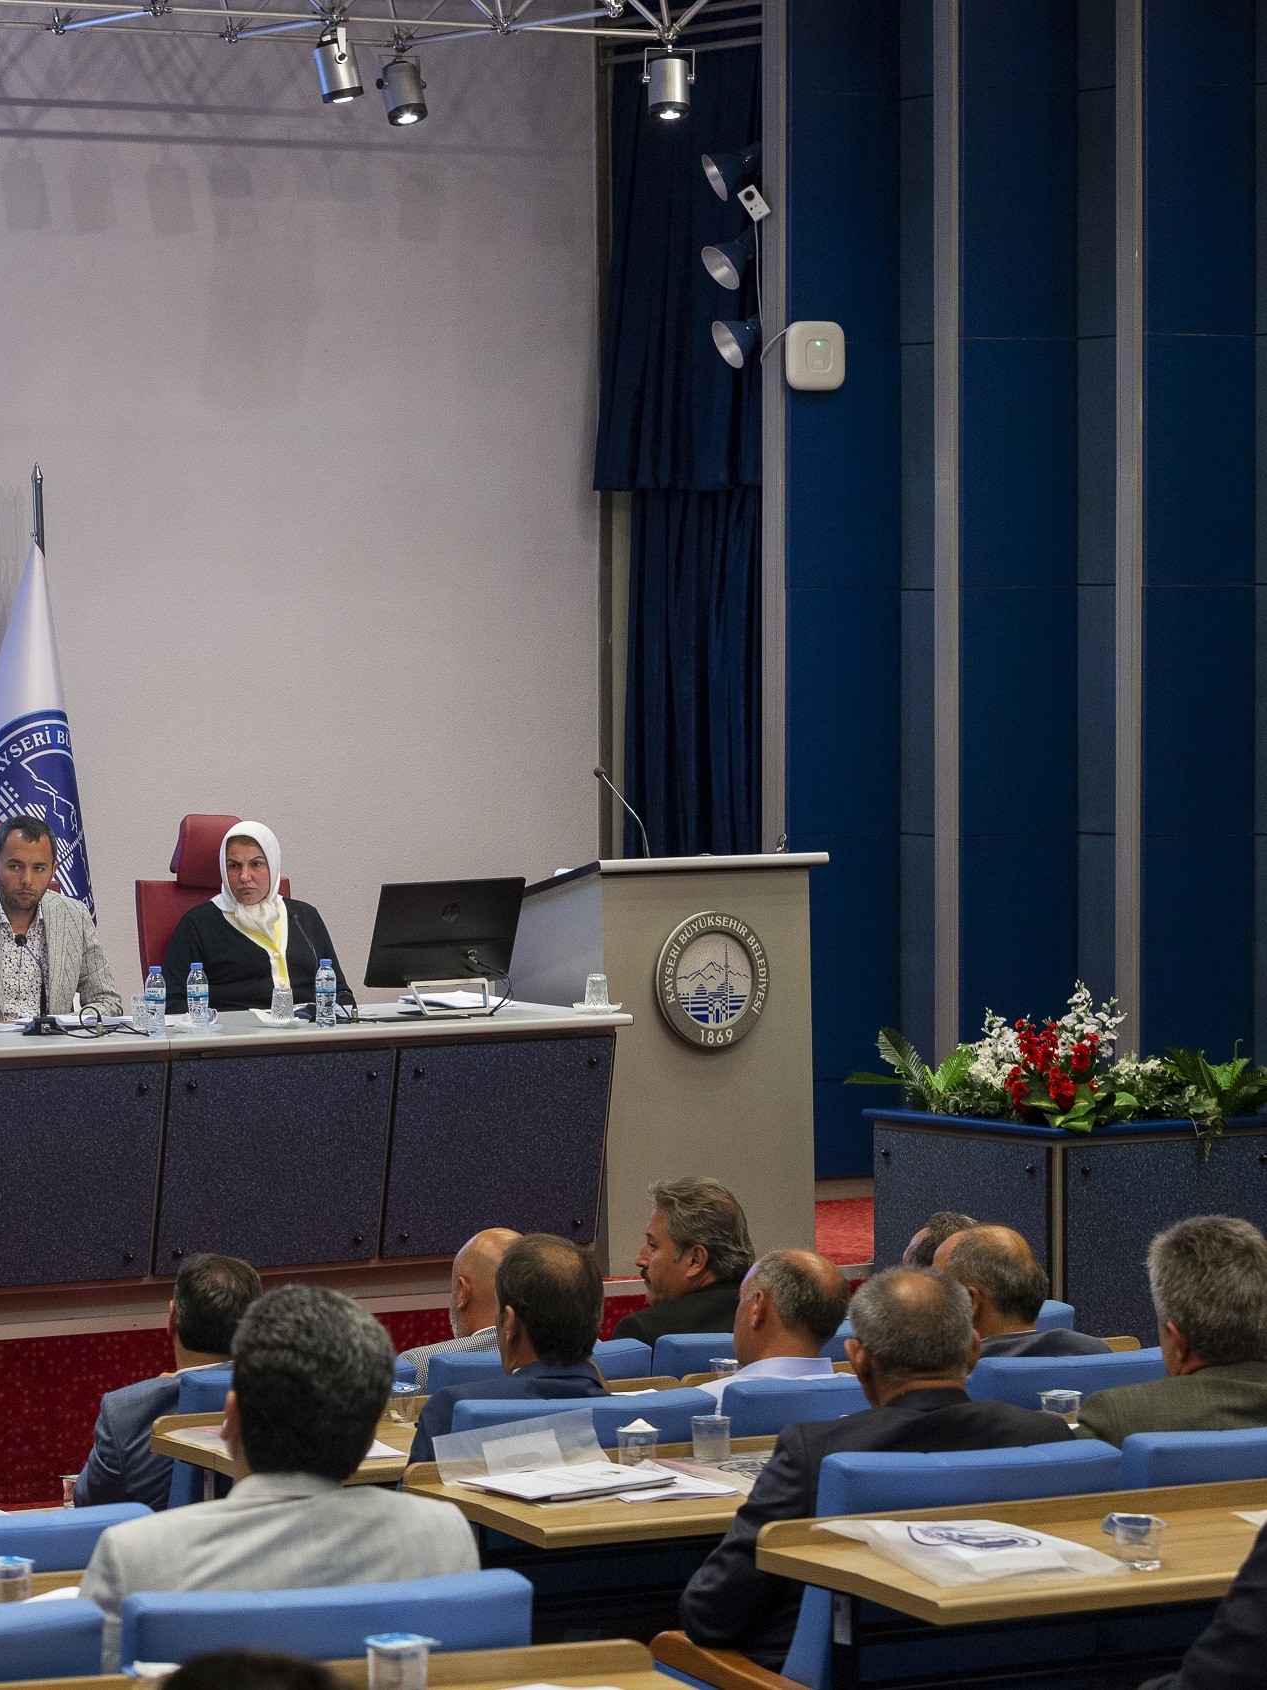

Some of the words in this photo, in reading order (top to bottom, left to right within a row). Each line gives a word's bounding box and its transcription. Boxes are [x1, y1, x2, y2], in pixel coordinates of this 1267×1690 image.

[664, 942, 681, 1004] KAYSERİ
[678, 915, 748, 945] BÜYÜKŞEHİR
[746, 934, 769, 1015] BELEDİYESİ
[700, 1029, 733, 1044] 1869
